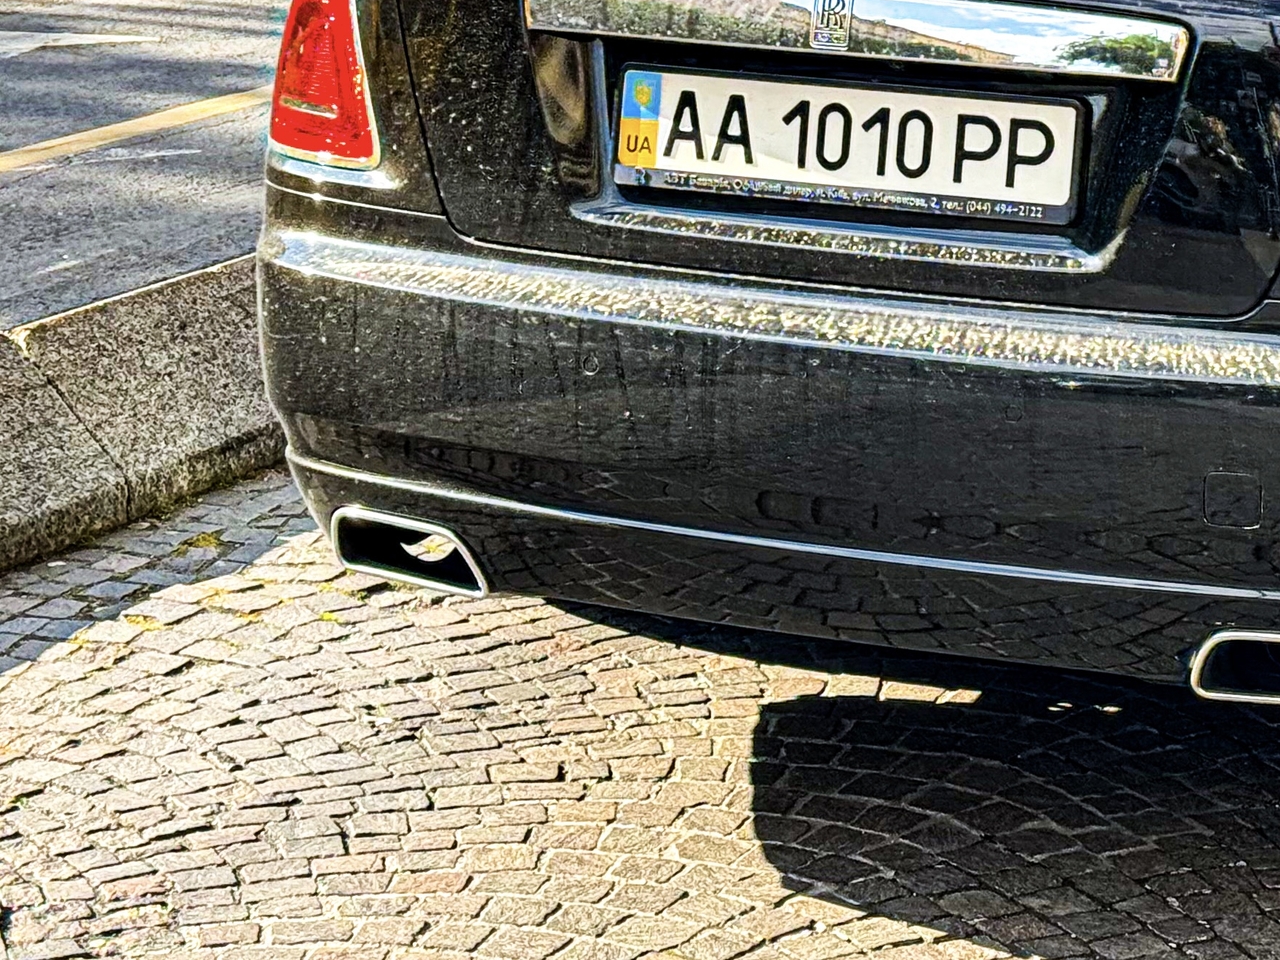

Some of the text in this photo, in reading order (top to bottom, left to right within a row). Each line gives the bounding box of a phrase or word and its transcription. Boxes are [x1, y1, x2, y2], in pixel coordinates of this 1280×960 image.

[626, 134, 652, 155] UA
[663, 90, 1055, 188] AA 1010 PP
[966, 200, 991, 214] (044)
[994, 203, 1043, 218] 494-2122
